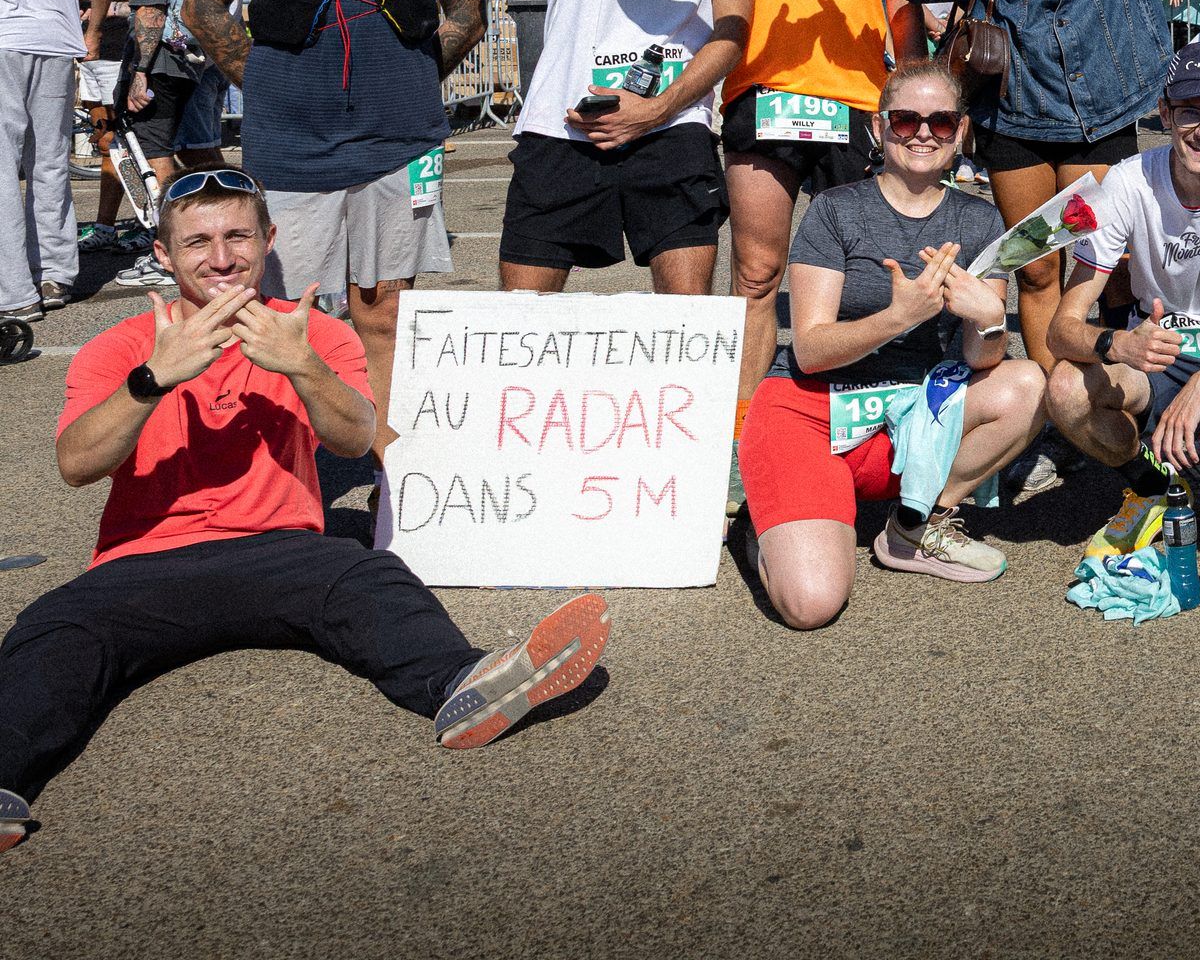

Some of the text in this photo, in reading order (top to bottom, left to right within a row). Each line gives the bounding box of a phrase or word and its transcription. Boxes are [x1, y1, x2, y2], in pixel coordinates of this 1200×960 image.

[595, 51, 638, 66] CARRO
[769, 96, 838, 117] 1196
[413, 384, 700, 454] AU RADAR
[398, 473, 677, 532] DANS 5 M
